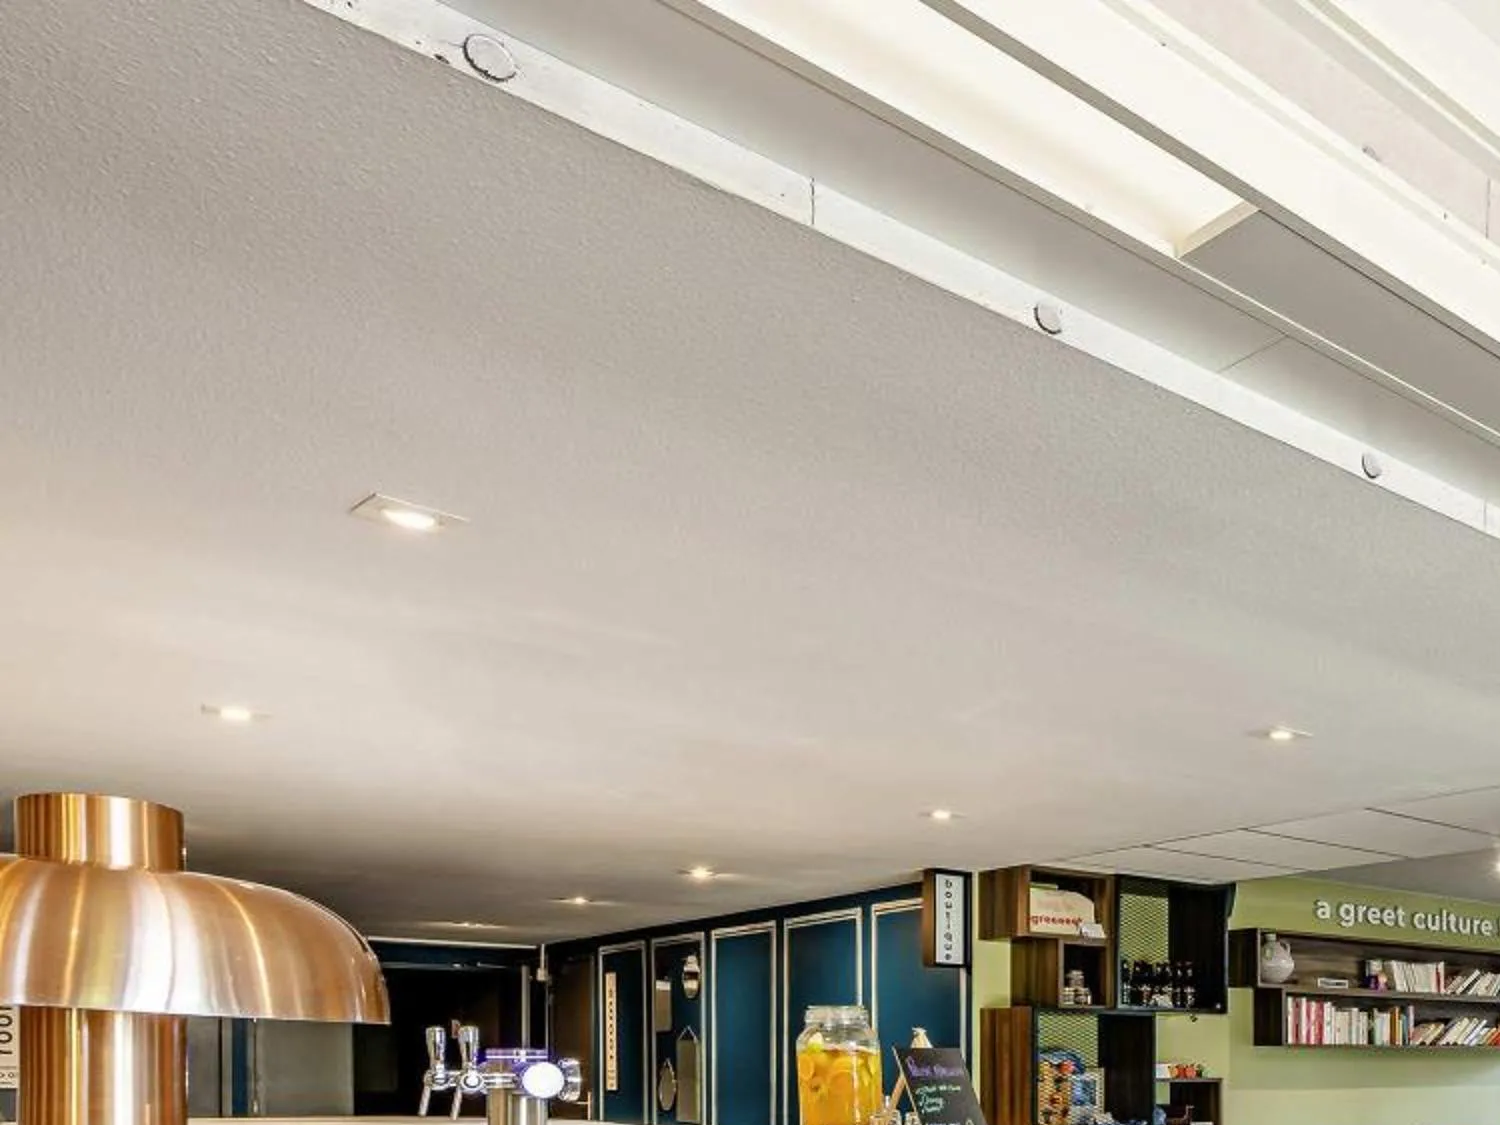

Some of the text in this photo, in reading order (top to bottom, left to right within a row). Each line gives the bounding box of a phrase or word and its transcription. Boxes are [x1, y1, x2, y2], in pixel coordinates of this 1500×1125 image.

[1316, 899, 1331, 919] a
[1338, 902, 1405, 928] greet
[1412, 909, 1493, 937] culture
